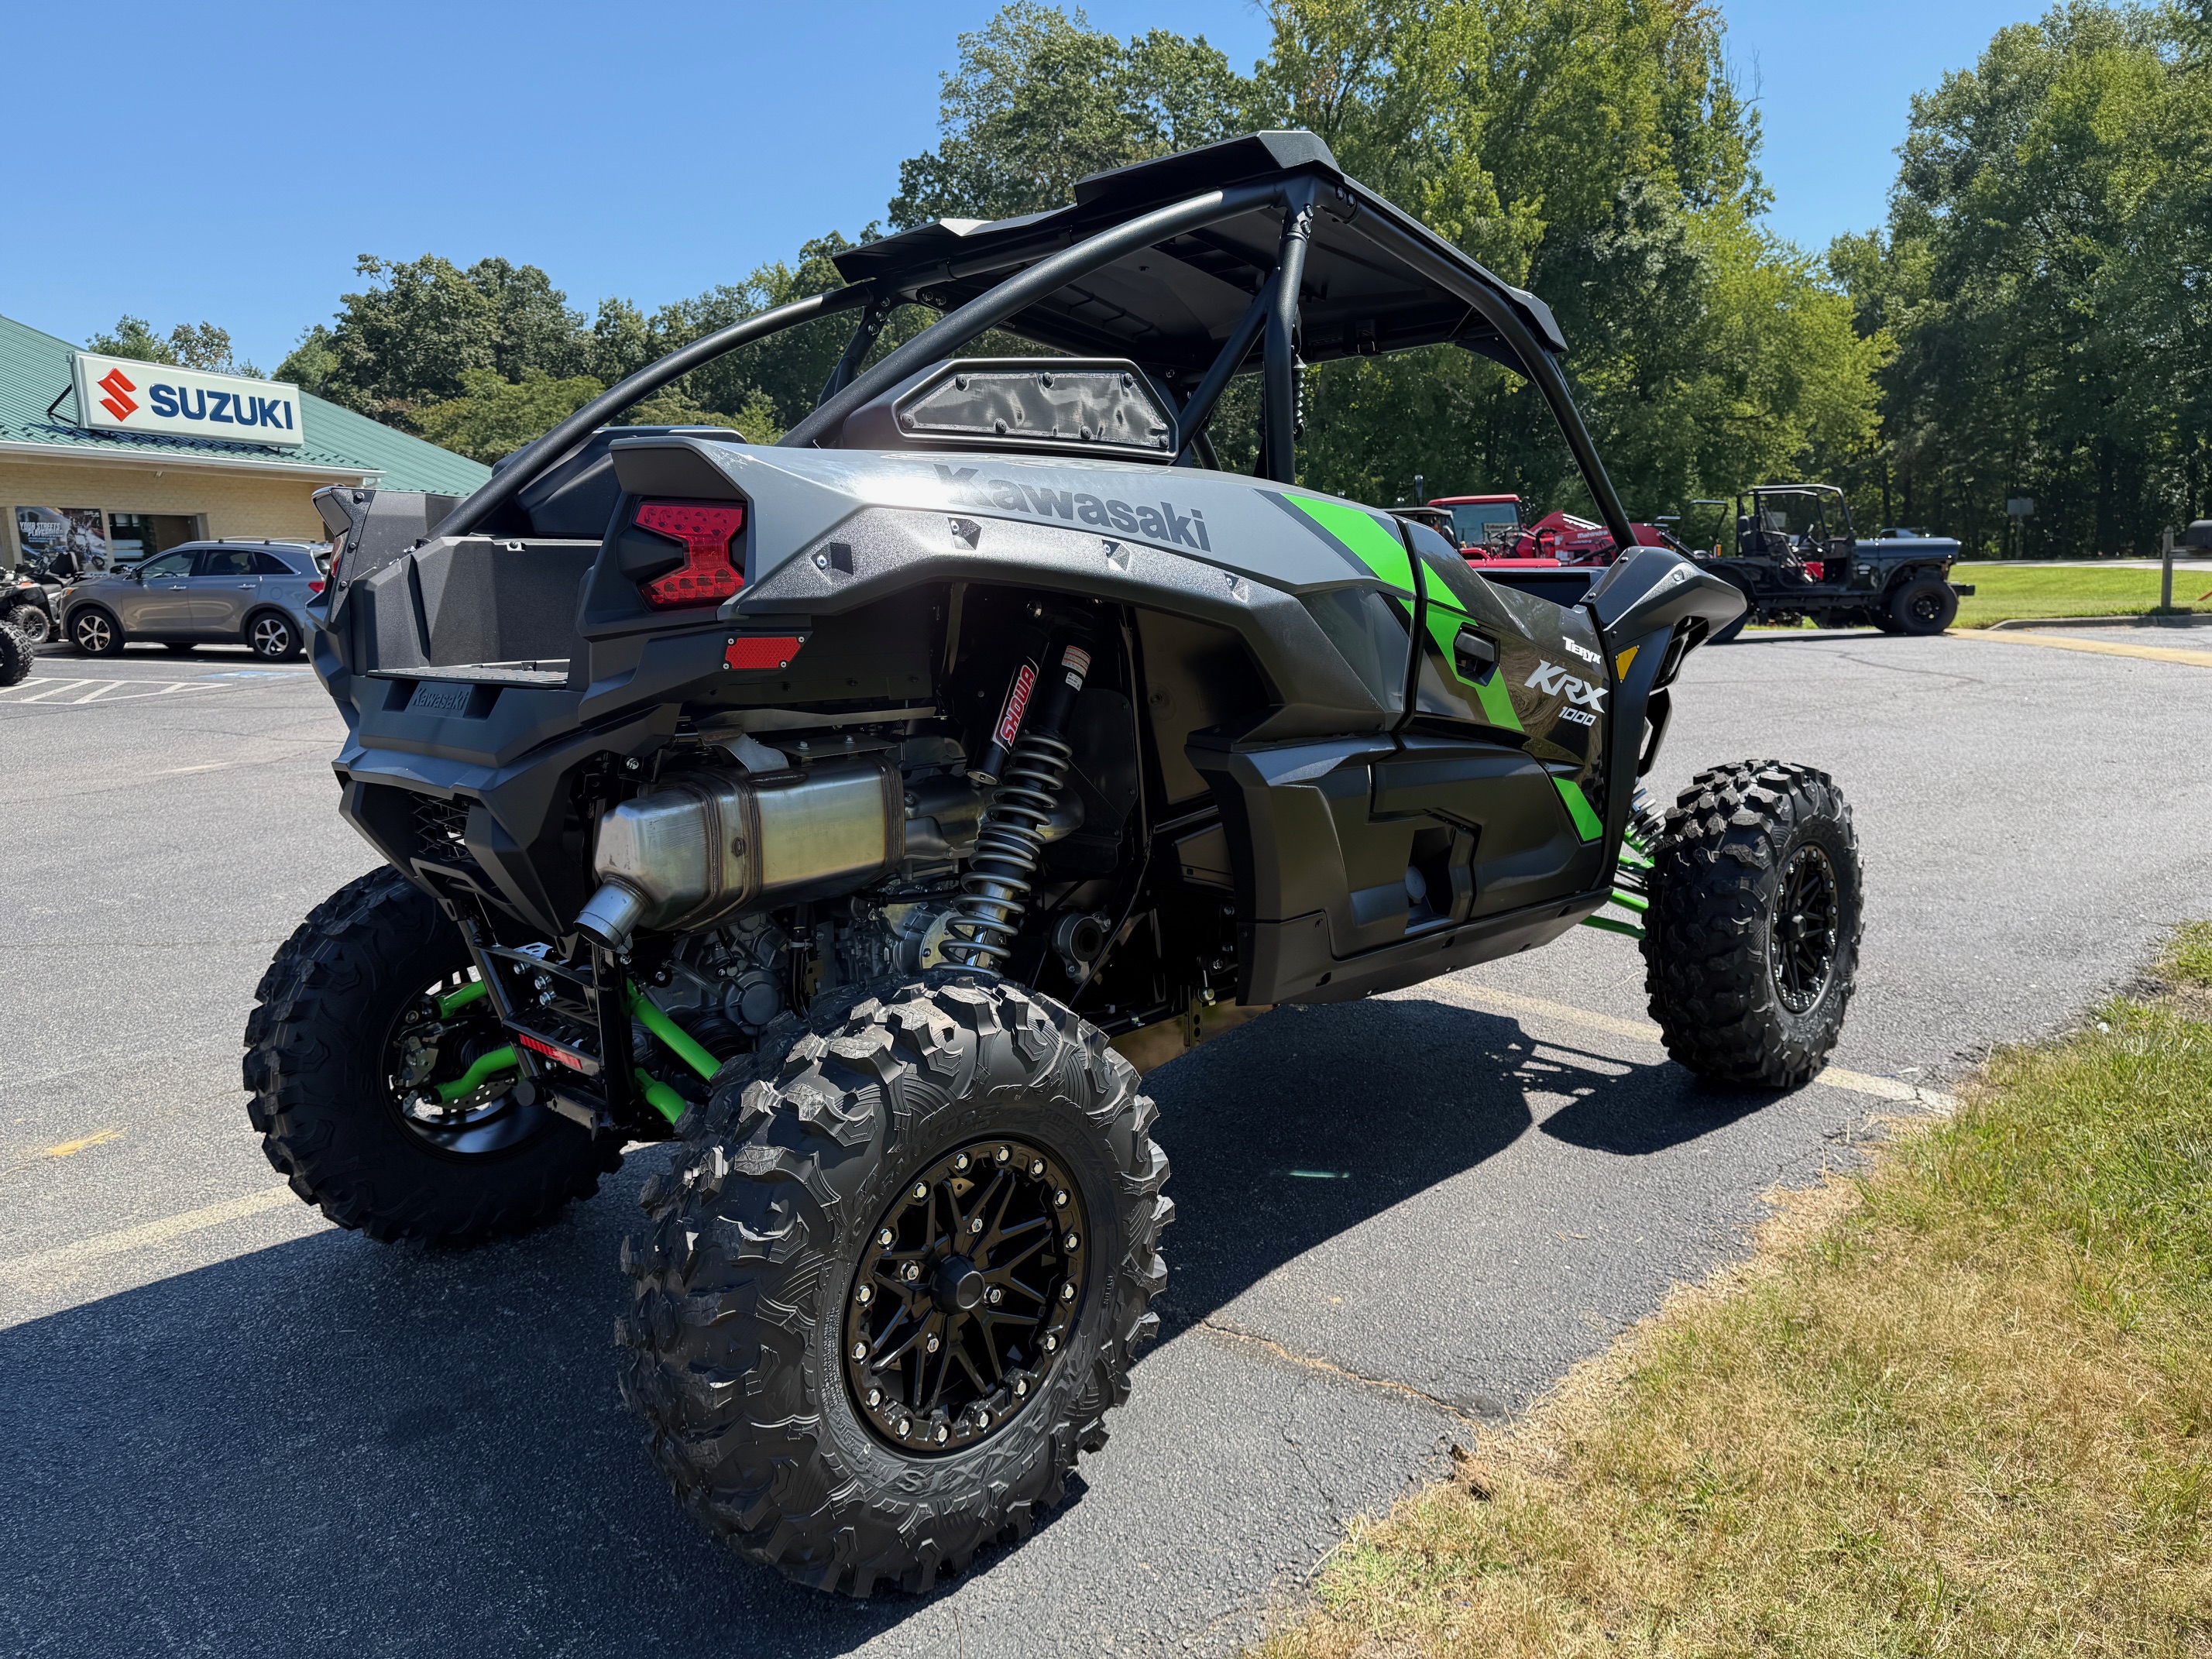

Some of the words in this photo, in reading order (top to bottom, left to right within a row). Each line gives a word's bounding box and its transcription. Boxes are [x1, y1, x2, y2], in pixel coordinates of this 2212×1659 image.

[149, 383, 294, 431] SUZUKI
[933, 463, 1211, 553] Kawasaki
[412, 687, 469, 710] Kawasaki
[1001, 665, 1035, 747] SHOWA
[1524, 659, 1609, 713] KRX
[1558, 706, 1596, 726] 1000
